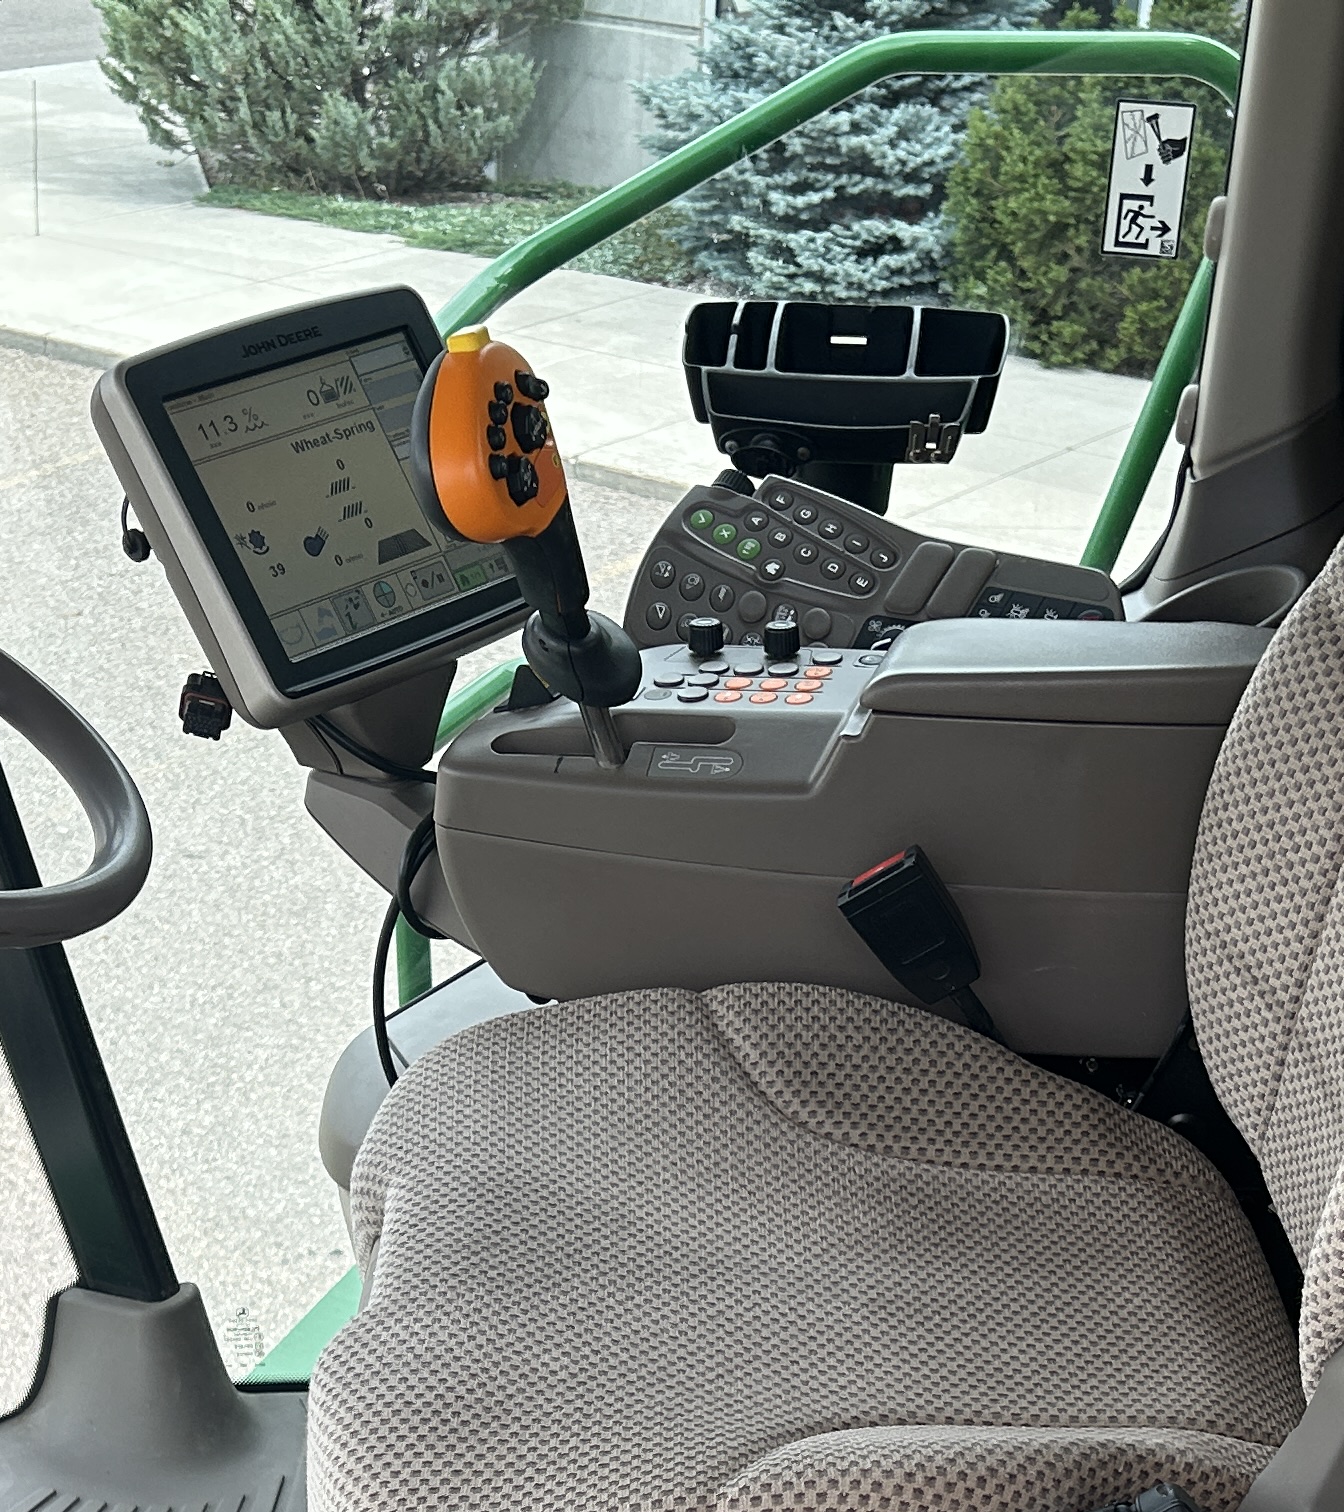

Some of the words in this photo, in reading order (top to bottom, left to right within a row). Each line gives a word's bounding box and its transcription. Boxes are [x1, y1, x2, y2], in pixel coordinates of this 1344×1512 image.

[241, 337, 276, 358] JOHN
[277, 326, 323, 348] DEERE
[306, 389, 320, 406] 0
[197, 414, 238, 441] 11.3
[290, 419, 376, 454] Wheat-Spring
[335, 458, 346, 471] 0
[776, 494, 786, 505] F
[245, 500, 256, 513] 0
[800, 509, 812, 519] G
[363, 516, 373, 529] 0
[751, 516, 763, 526] A
[824, 524, 838, 533] H
[774, 532, 787, 542] B
[800, 548, 812, 557] C
[878, 554, 889, 563] J
[334, 554, 344, 567] 0
[268, 562, 286, 578] 39
[827, 563, 840, 573] D
[856, 577, 869, 588] E
